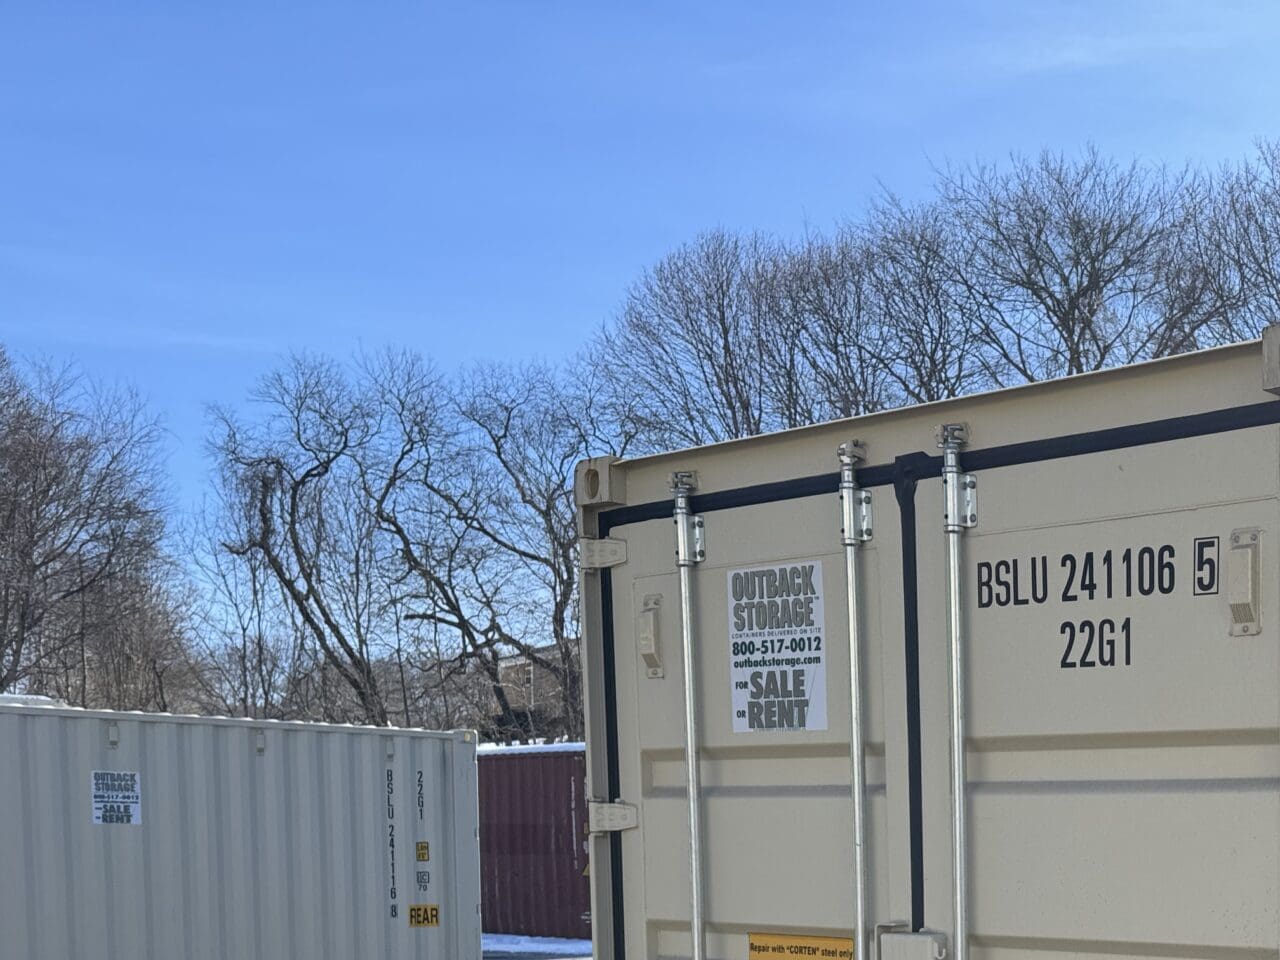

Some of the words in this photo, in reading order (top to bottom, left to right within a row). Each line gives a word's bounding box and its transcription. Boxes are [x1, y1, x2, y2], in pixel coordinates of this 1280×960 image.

[731, 565, 816, 601] OUTBACK
[977, 556, 1048, 608] BSLU
[1061, 544, 1175, 602] 241106
[1196, 540, 1216, 592] 5
[733, 597, 815, 632] STORAGE
[732, 636, 821, 656] 800-517-0012
[1060, 617, 1131, 668] 22G1
[733, 655, 821, 669] outbackstorage.com
[735, 681, 748, 690] FOR
[750, 669, 806, 699] SALE
[736, 710, 746, 718] OR
[747, 699, 809, 729] RENT
[102, 804, 131, 814] SALE
[386, 769, 394, 819] BSLU
[416, 771, 424, 820] 22G1
[388, 824, 397, 900] 241116
[410, 907, 439, 924] REAR
[749, 943, 769, 954] Repair
[772, 944, 785, 953] with
[821, 948, 838, 957] steel
[839, 949, 853, 960] only
